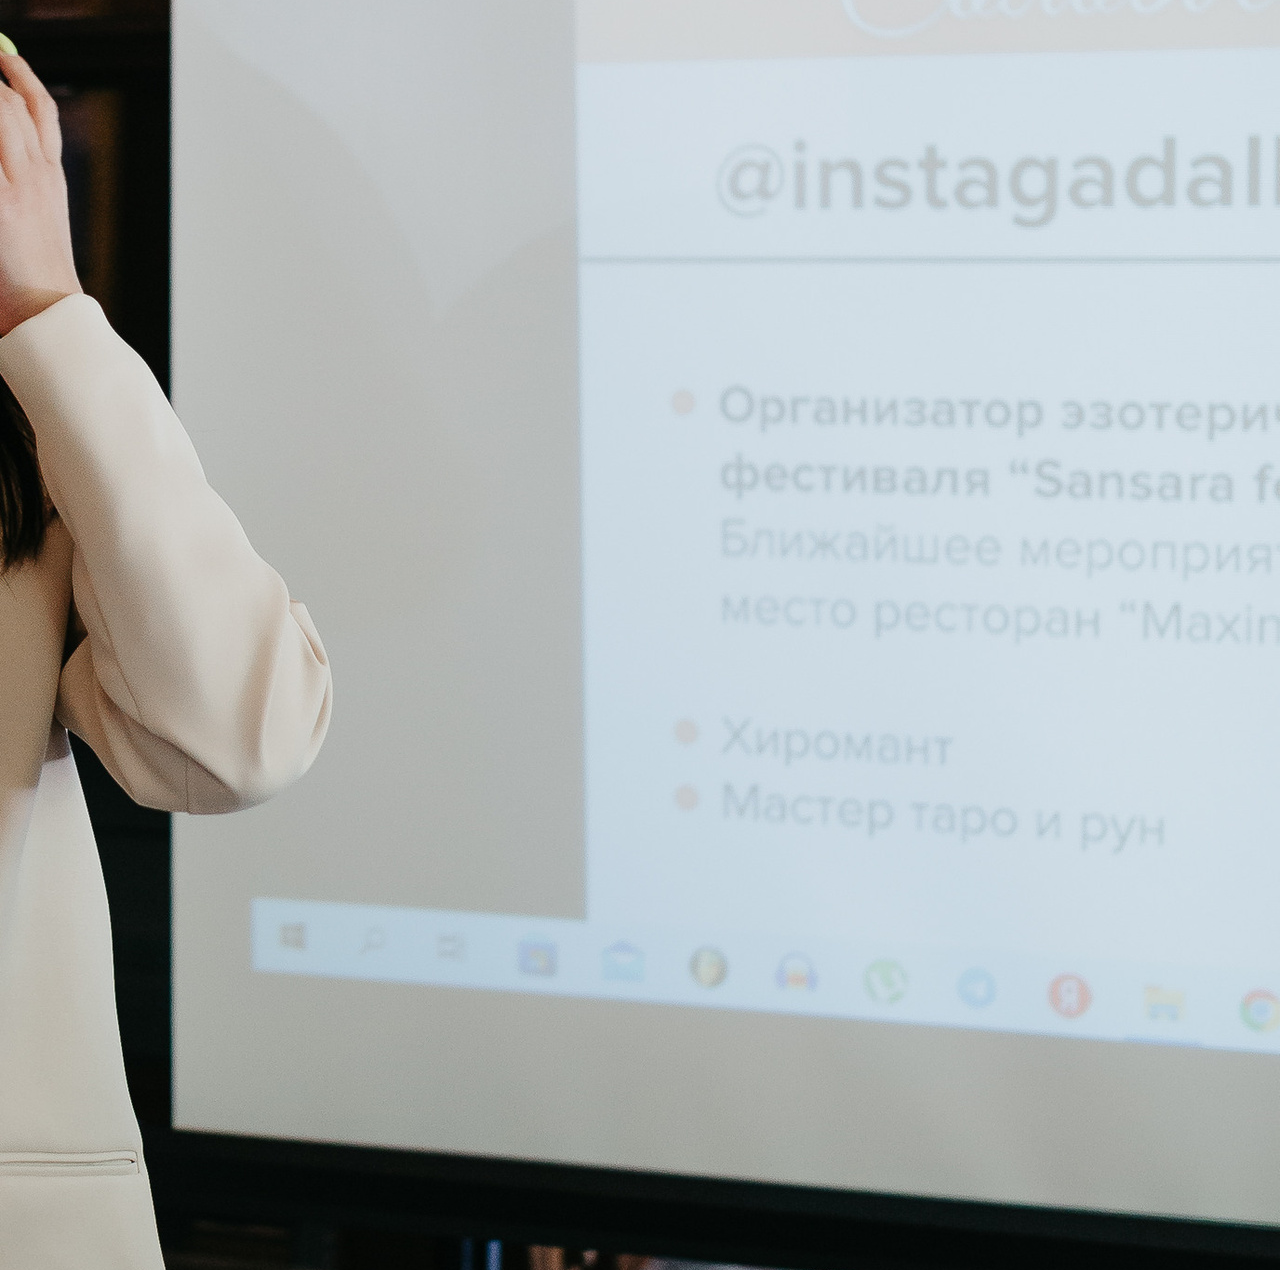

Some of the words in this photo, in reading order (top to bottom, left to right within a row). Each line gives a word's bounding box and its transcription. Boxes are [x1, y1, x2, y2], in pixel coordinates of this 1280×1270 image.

[718, 383, 1045, 439] Организатор
[1061, 398, 1280, 443] эзотери
[719, 452, 991, 501] фестиваля
[720, 516, 1003, 567] Ближайшее
[1019, 534, 1280, 583] мероприя
[720, 594, 858, 630] место
[873, 598, 1102, 646] ресторан
[721, 715, 954, 767] Хиромант
[721, 781, 896, 839] Мастер
[909, 799, 1020, 844] таро
[1034, 810, 1062, 840] и
[1079, 811, 1166, 856] рун
